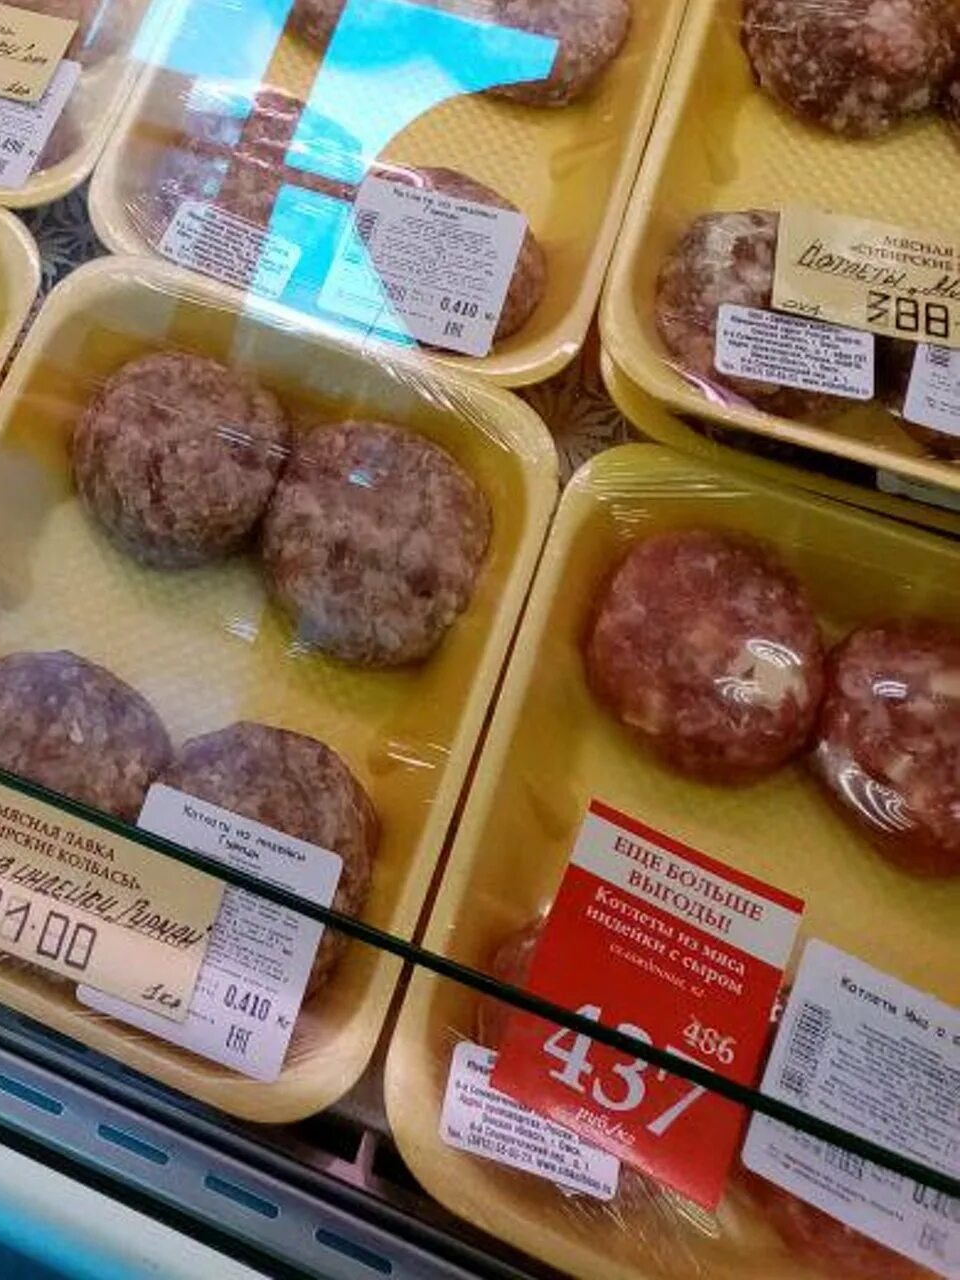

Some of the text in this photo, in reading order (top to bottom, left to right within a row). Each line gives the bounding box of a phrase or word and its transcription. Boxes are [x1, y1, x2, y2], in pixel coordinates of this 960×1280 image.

[57, 849, 142, 890] КОЛБАСЫ»
[61, 829, 116, 863] ЛАВКА
[614, 835, 765, 922] ЕЩЕ БОЛЬШЕ
[594, 885, 746, 978] Котлеты из мяса
[627, 868, 733, 935] ВЫГОДЫ!
[584, 904, 744, 995] индейки с сыром
[223, 983, 272, 1021] 0.410
[543, 1003, 716, 1136] 437
[682, 1013, 737, 1064] 486
